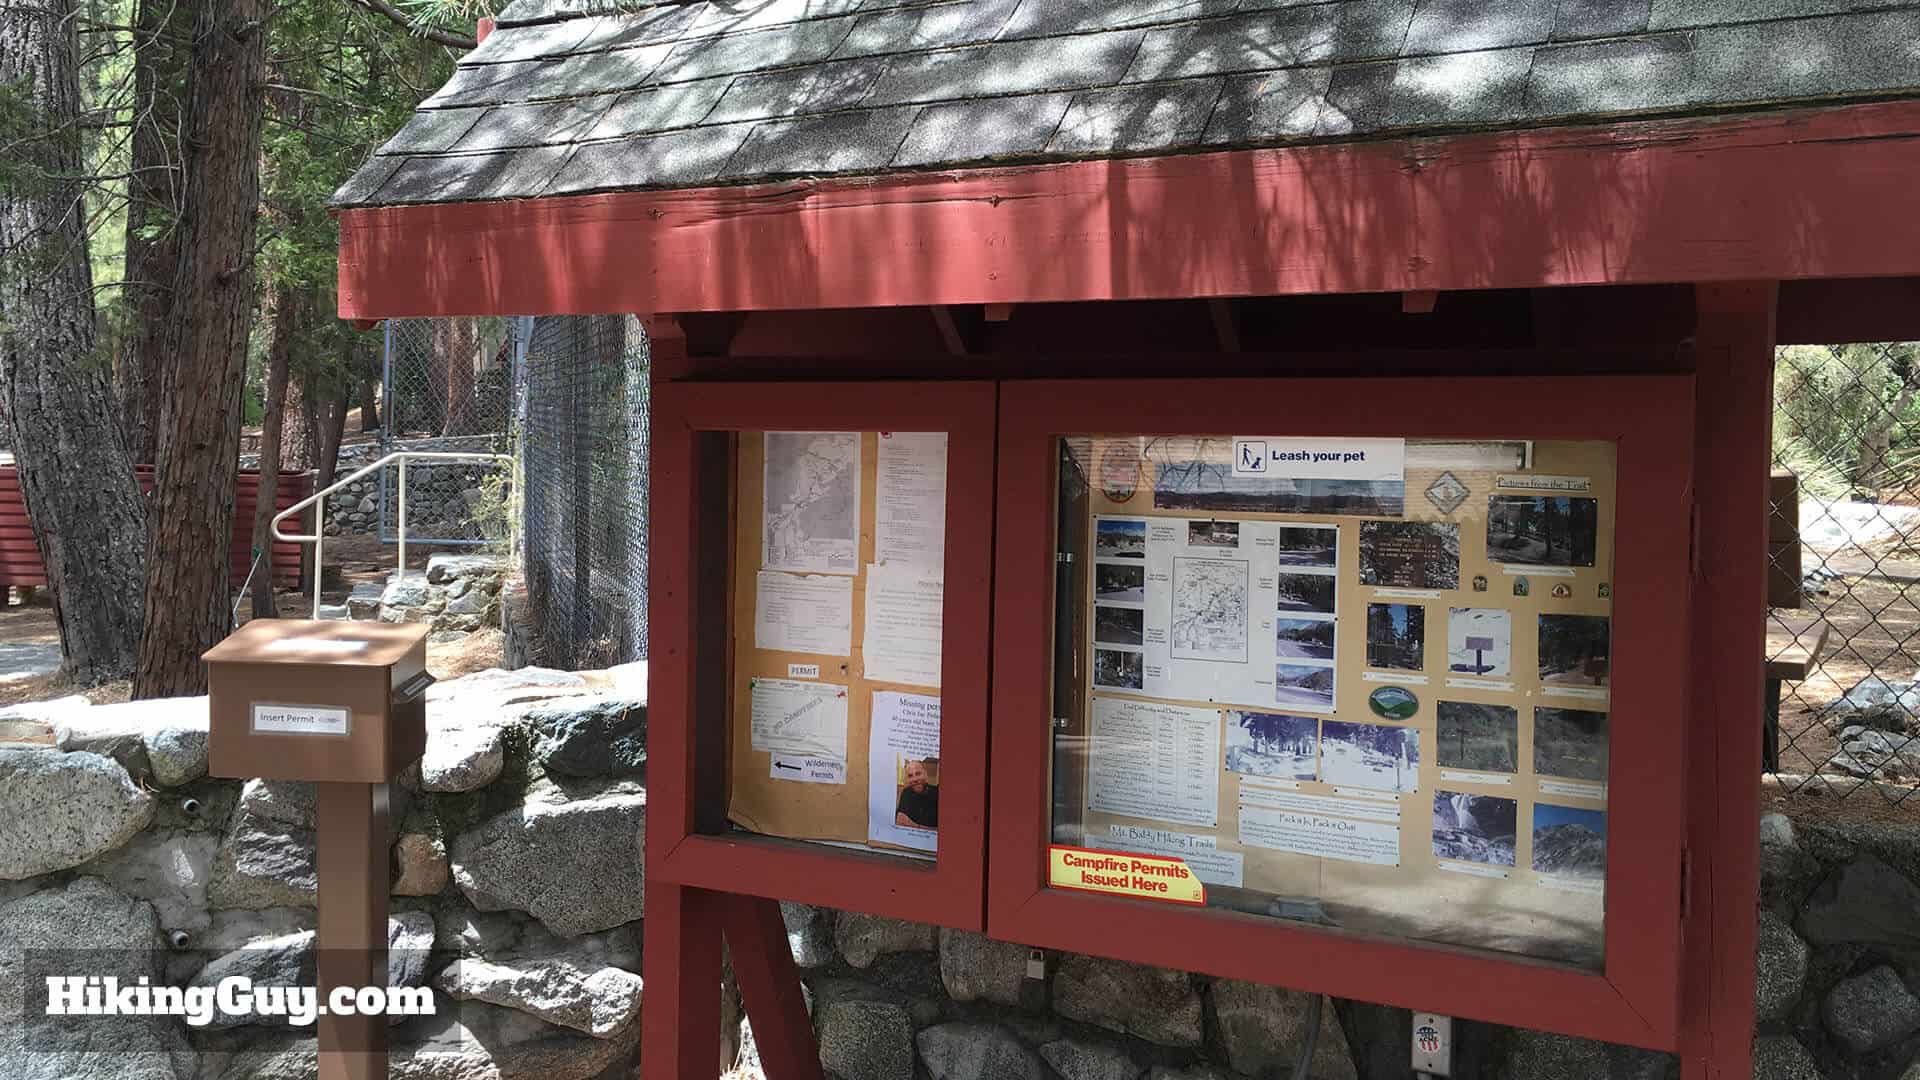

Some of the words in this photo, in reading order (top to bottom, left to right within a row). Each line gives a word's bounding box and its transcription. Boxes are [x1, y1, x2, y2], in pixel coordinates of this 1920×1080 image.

[1272, 450, 1310, 461] Leash
[1313, 452, 1341, 463] your
[1343, 451, 1366, 463] pet
[1550, 479, 1563, 489] the
[791, 667, 816, 675] PERMIT
[260, 712, 284, 721] Insert
[287, 714, 314, 723] Permit
[811, 770, 834, 779] Permits
[1280, 813, 1296, 823] Pack
[1313, 817, 1329, 828] Pack
[1063, 853, 1129, 872] Campfire
[1131, 860, 1189, 879] Permits
[1082, 870, 1129, 888] Issued
[1132, 876, 1168, 892] Here
